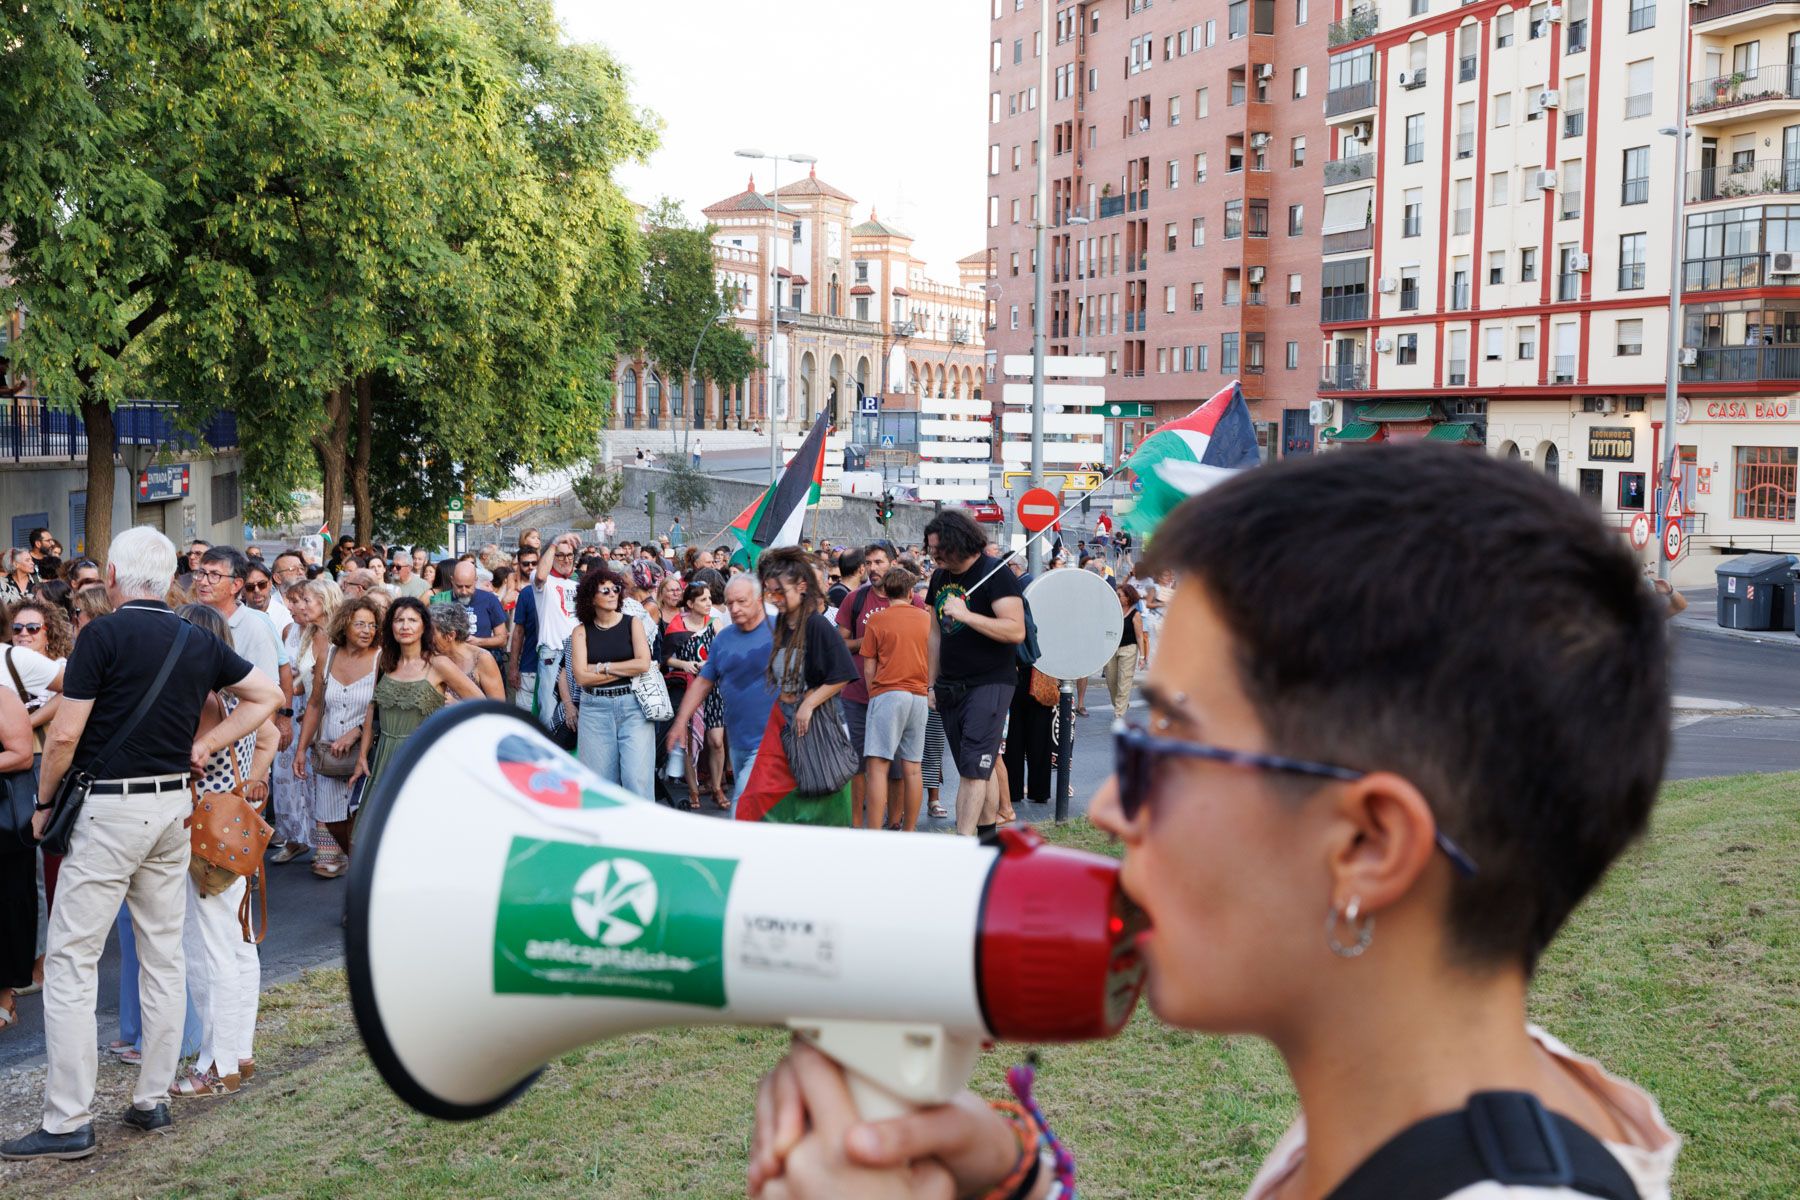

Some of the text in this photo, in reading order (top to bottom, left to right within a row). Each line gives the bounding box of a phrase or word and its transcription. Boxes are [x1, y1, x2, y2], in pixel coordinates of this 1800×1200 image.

[1707, 402, 1788, 418] CASA BAO
[1592, 430, 1631, 439] IRONHORSE
[1590, 439, 1632, 457] TATTOO
[147, 472, 167, 484] ENTRADA
[1668, 533, 1679, 547] 30
[525, 939, 696, 972] anticapitalistas
